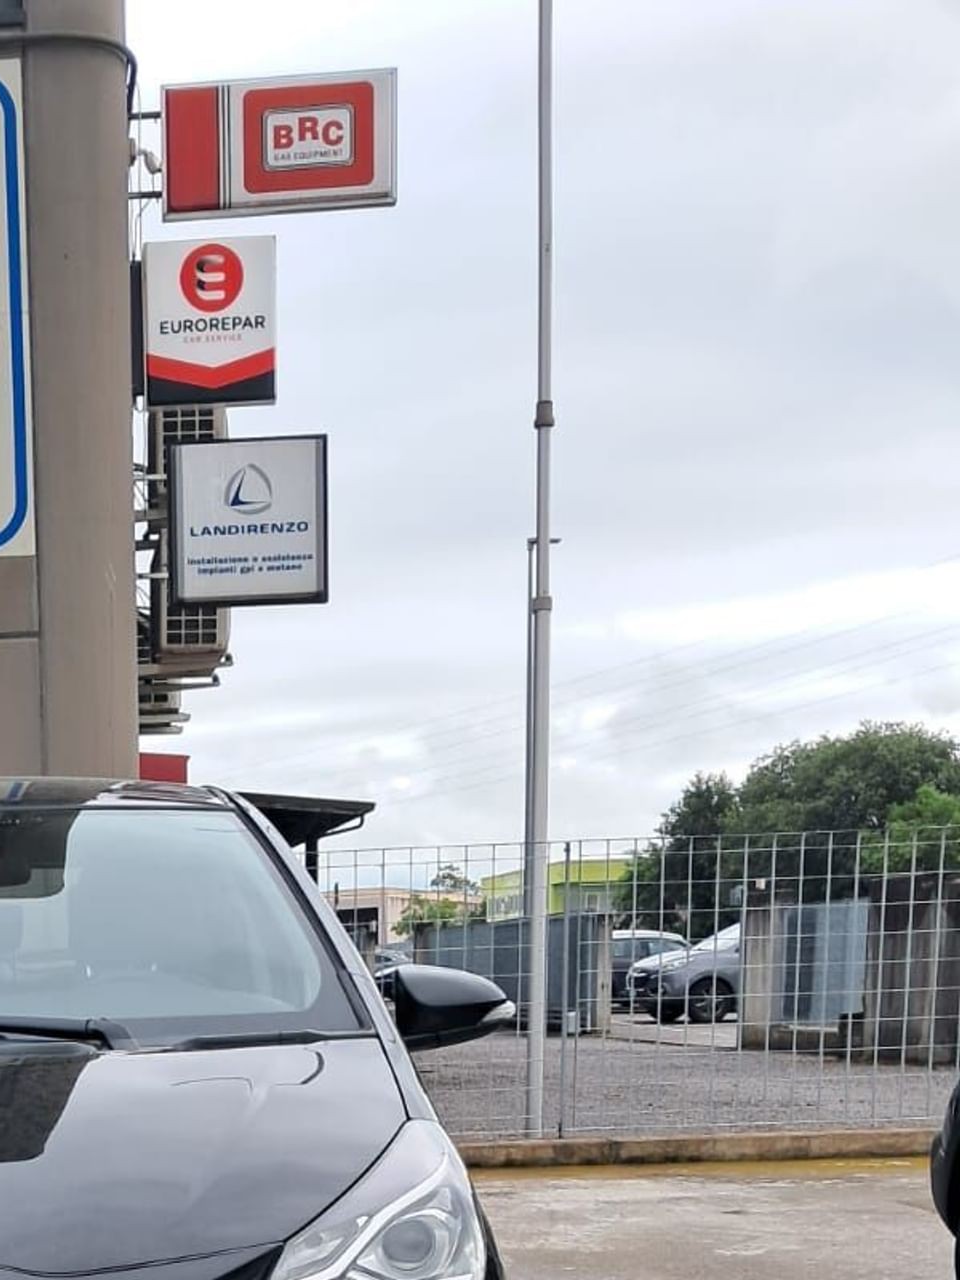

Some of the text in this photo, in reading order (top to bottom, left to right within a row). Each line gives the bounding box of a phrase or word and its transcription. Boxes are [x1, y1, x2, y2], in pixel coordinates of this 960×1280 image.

[273, 116, 344, 149] BRC
[159, 315, 266, 335] EUROREPAR
[190, 521, 309, 537] LANDIRENZO
